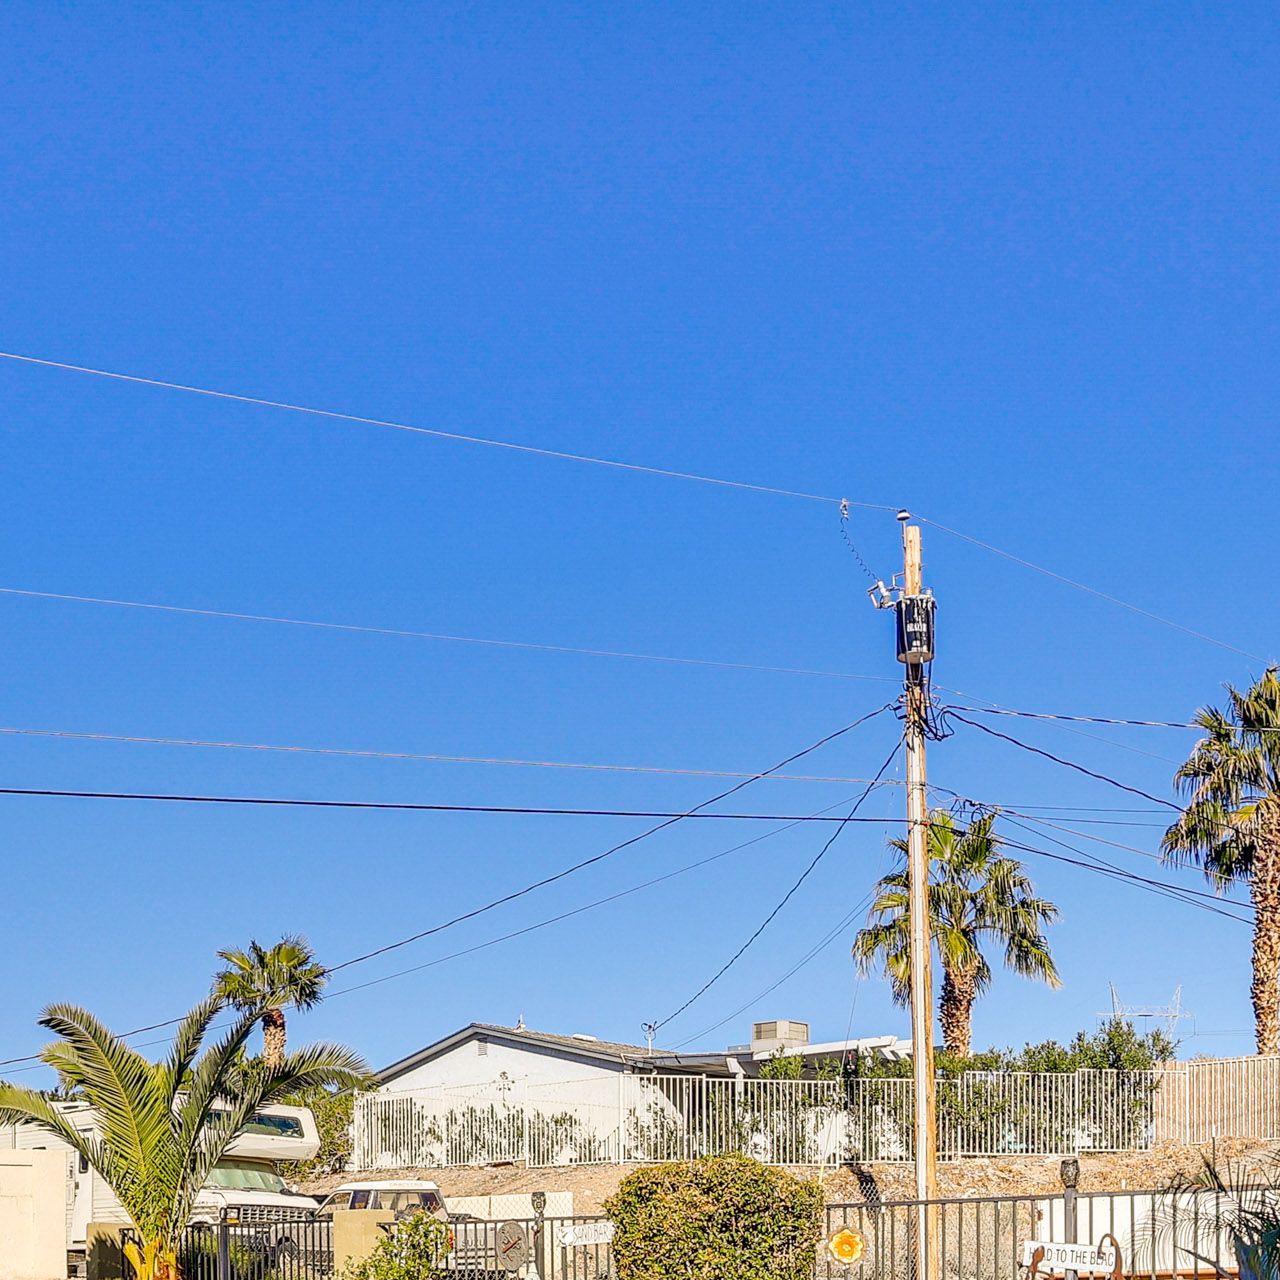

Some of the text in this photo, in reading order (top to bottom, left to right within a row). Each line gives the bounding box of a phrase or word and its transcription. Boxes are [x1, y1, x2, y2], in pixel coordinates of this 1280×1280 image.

[1029, 1247, 1114, 1267] HD TO THE BAC
